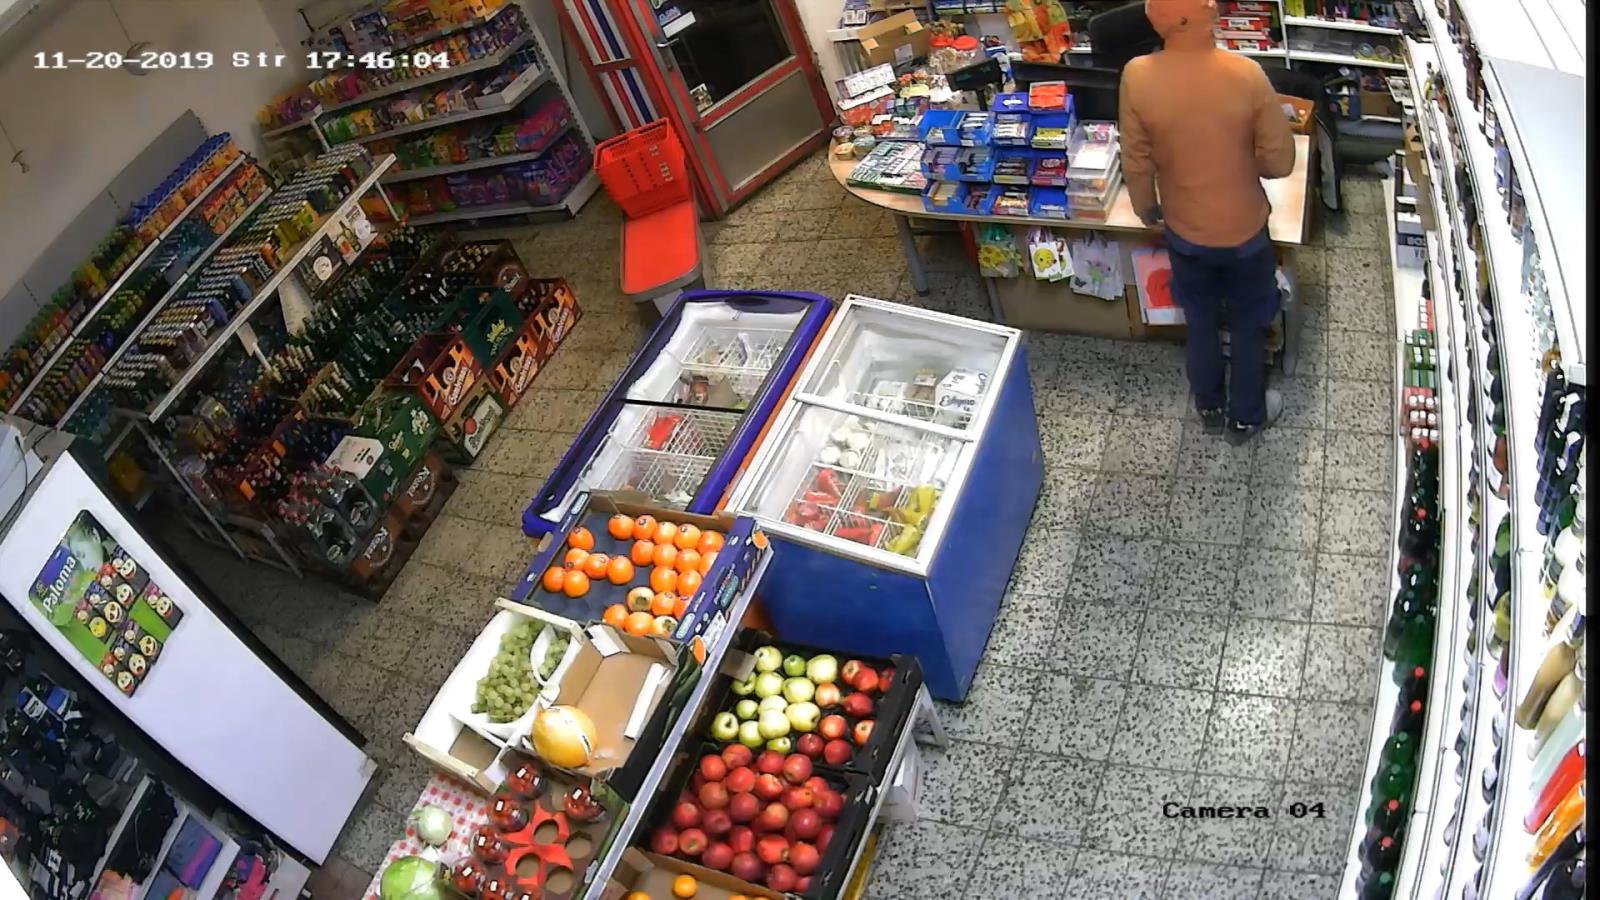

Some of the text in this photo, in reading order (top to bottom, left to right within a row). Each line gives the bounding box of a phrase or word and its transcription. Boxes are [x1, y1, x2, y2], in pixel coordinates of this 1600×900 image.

[448, 366, 470, 405] Gambrinus
[406, 465, 431, 498] Kozel
[364, 526, 389, 560] Kozel
[42, 555, 76, 613] Paloma
